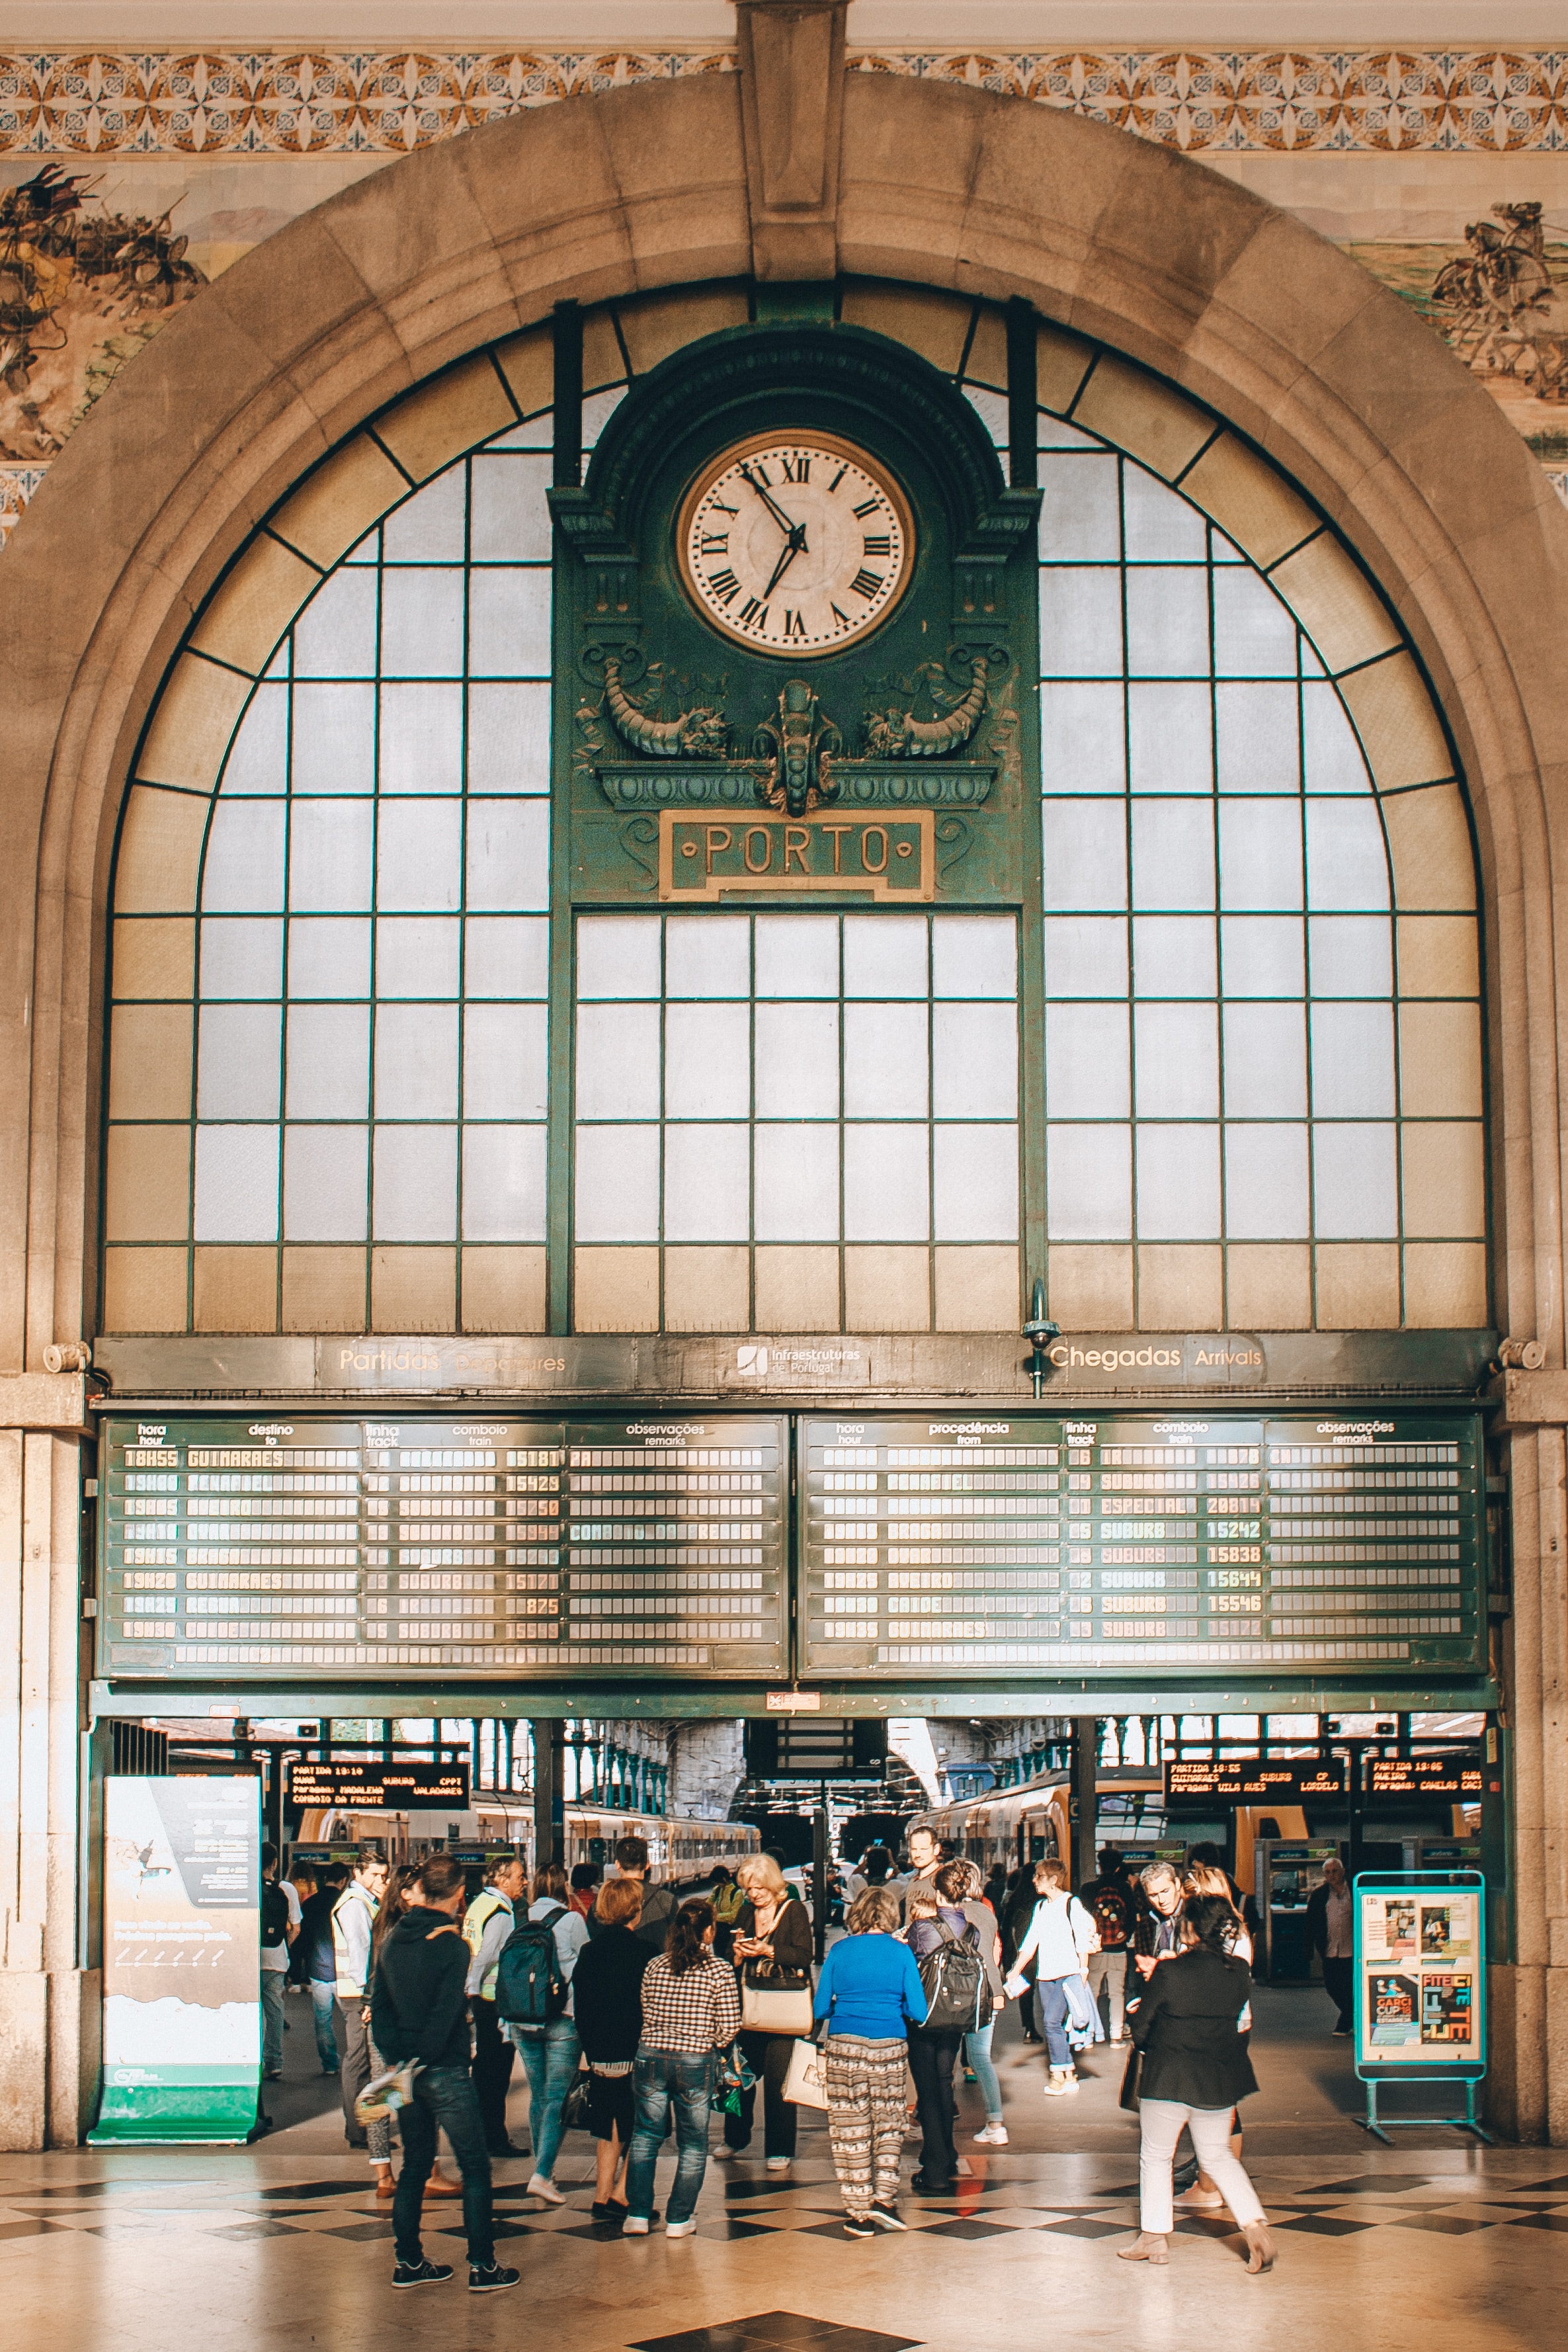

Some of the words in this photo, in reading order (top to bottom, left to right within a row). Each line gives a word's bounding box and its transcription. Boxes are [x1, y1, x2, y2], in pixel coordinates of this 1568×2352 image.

[781, 457, 811, 483] XII
[827, 468, 846, 493] I
[710, 496, 740, 521] X
[852, 497, 881, 520] II
[701, 530, 729, 556] IX
[864, 535, 889, 556] III
[708, 567, 743, 607] VIII
[848, 567, 885, 601] IIII
[737, 596, 769, 630] VII
[830, 601, 851, 627] V
[784, 609, 807, 636] VI
[706, 825, 889, 873] PORTO
[340, 1349, 442, 1371] Partidas
[456, 1355, 565, 1372] Departures
[772, 1349, 860, 1361] Infraestruturas
[1050, 1345, 1181, 1372] Chegadas
[1194, 1349, 1261, 1366] Arrivals
[772, 1362, 785, 1373] de
[791, 1362, 834, 1375] Portugal
[138, 1423, 167, 1435] hora
[248, 1423, 294, 1436] destino
[366, 1424, 400, 1437] linha
[452, 1424, 508, 1435] comboio
[626, 1423, 705, 1437] observações
[836, 1423, 865, 1434] hora
[929, 1422, 1010, 1435] procedência
[1066, 1422, 1096, 1434] linha
[1153, 1421, 1210, 1433] comboio
[1316, 1421, 1395, 1434] observações
[139, 1436, 164, 1446] hour
[265, 1436, 278, 1446] to
[366, 1436, 399, 1447] track
[469, 1436, 491, 1446] train
[645, 1436, 686, 1446] remarks
[838, 1435, 862, 1445] hour
[957, 1435, 981, 1445] from
[1067, 1434, 1096, 1445] track
[1168, 1434, 1193, 1445] train
[1332, 1434, 1374, 1444] remarks
[124, 1450, 178, 1467] 18H55
[187, 1450, 284, 1467] GUIMARAES
[506, 1450, 559, 1467] 15181
[506, 1476, 559, 1492] 15429
[1102, 1498, 1186, 1515] ESPECIAL
[1080, 1523, 1092, 1540] 5
[1100, 1523, 1165, 1540] SUBURB
[1208, 1522, 1261, 1538] 15242
[1209, 1546, 1262, 1563] 15838
[186, 1572, 282, 1589] GUIMARAES
[1101, 1572, 1166, 1588] SUBURB
[1208, 1571, 1262, 1587] 15644
[378, 1598, 388, 1614] 6
[527, 1598, 559, 1614] 875
[1102, 1596, 1166, 1613] SUBURB
[1209, 1595, 1262, 1613] 15546
[887, 1622, 986, 1638] GUIMARAES
[1102, 1621, 1166, 1638] SUBURB
[292, 1766, 332, 1775] PARTIDA
[1170, 1763, 1210, 1773] PARTIDA
[1373, 1761, 1413, 1771] PARTIDA
[1170, 1783, 1212, 1793] Paragem:
[350, 1796, 384, 1804] FRENTE
[1377, 1997, 1412, 2006] GARCI
[1377, 2006, 1400, 2015] CUP
